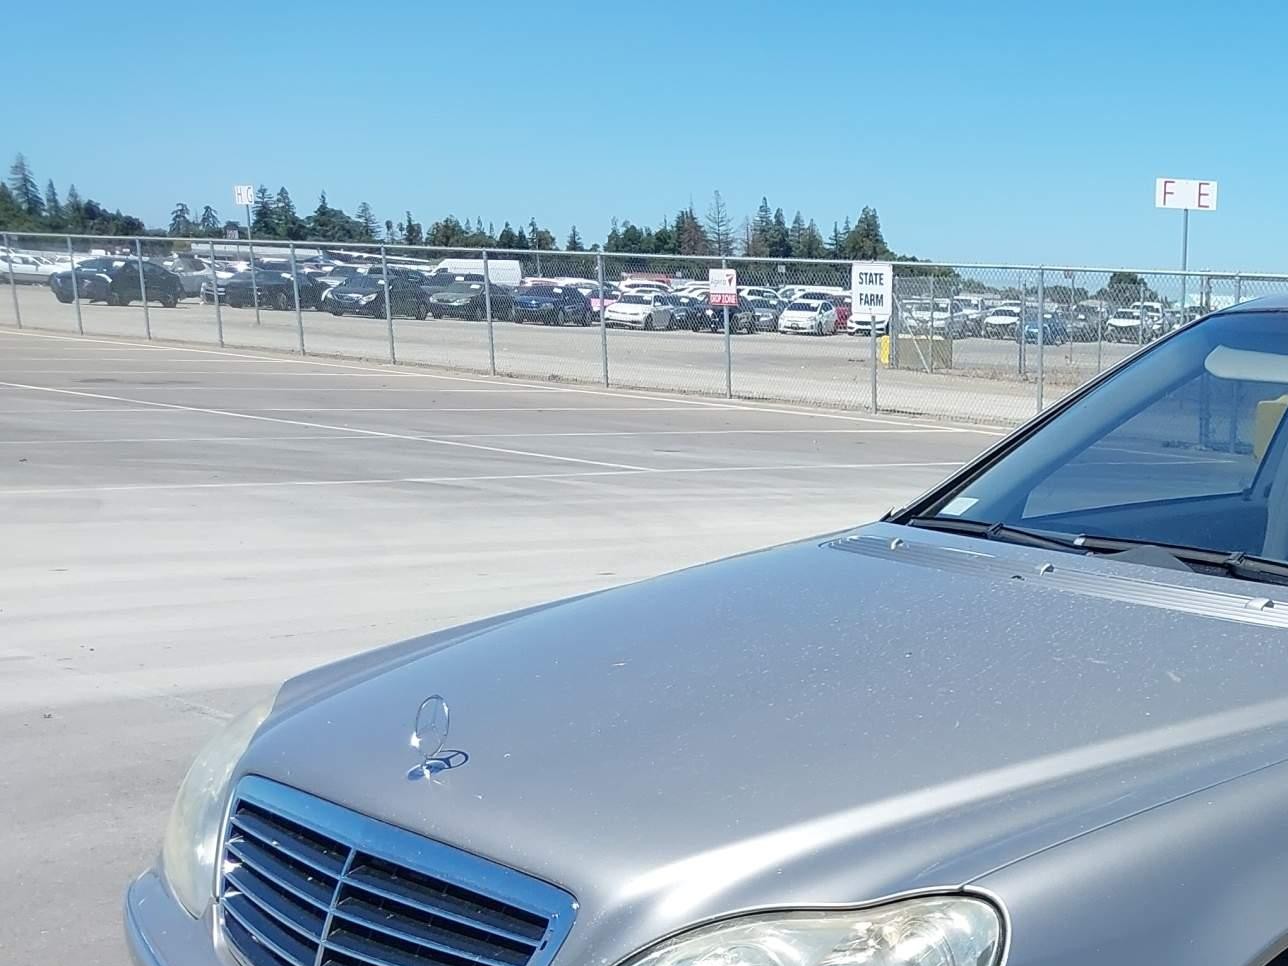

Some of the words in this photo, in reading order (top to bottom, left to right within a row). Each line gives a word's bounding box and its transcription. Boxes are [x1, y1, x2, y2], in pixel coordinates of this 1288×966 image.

[1163, 180, 1175, 206] F
[1198, 182, 1211, 208] E
[858, 271, 884, 286] STATE
[859, 292, 884, 308] FARM
